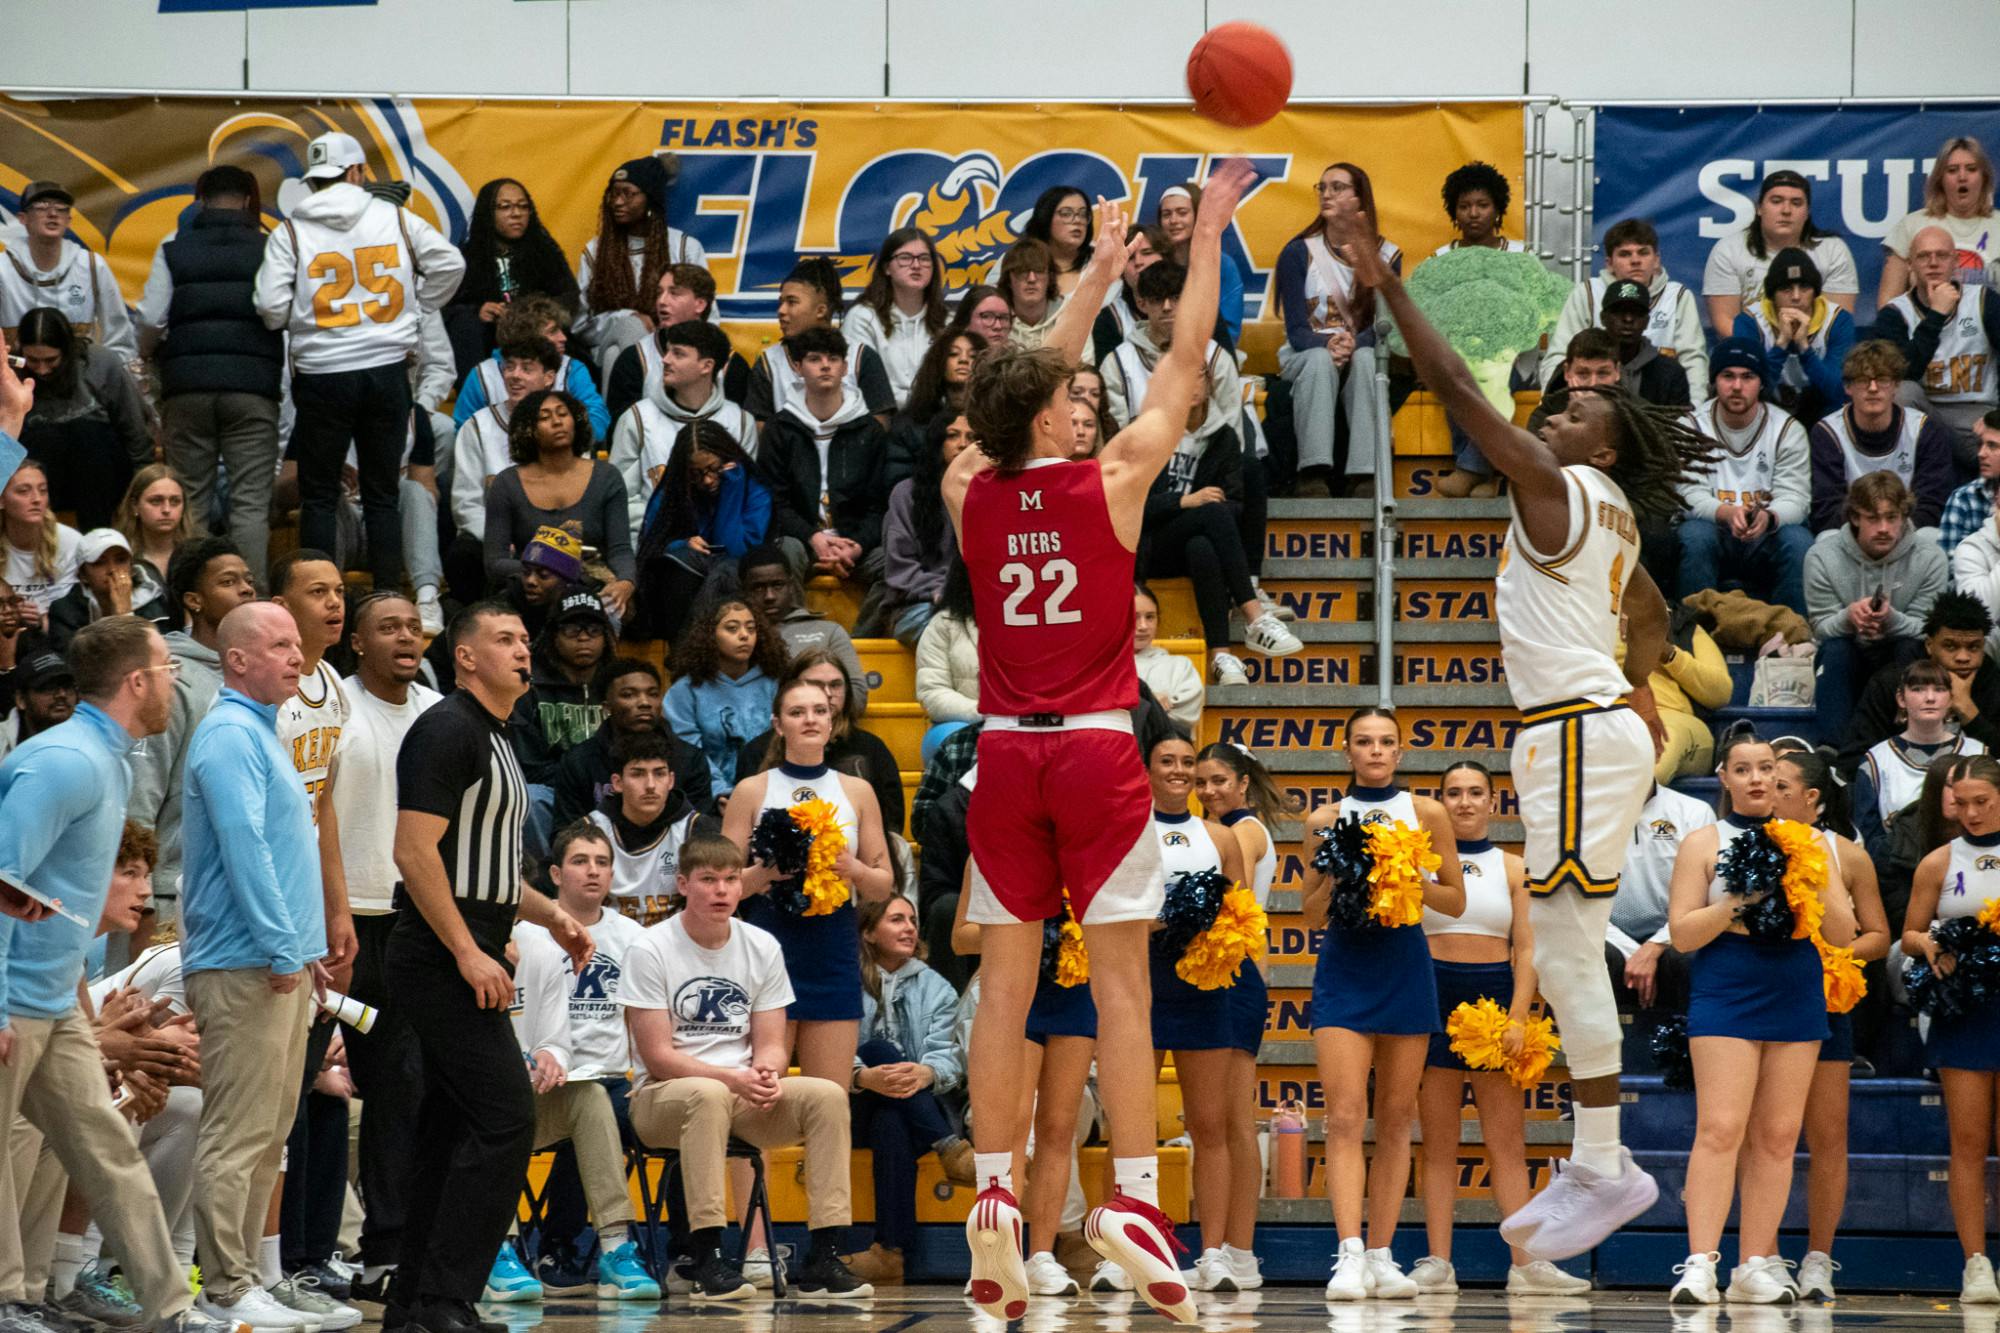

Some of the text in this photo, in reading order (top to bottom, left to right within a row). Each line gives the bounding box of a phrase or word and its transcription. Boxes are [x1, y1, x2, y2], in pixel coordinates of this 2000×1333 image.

[660, 117, 818, 147] FLASH'S
[1698, 160, 1940, 238] STU
[307, 243, 404, 329] 25
[1926, 354, 1988, 396] ENT
[1019, 489, 1043, 511] M
[1007, 531, 1062, 556] BYERS
[1268, 533, 1505, 558] LDEN FLASH
[999, 558, 1082, 626] 22
[1269, 591, 1497, 619] NT STA
[1246, 658, 1507, 683] OLDEN FLASH
[1220, 718, 1524, 749] KENT STAT
[1267, 928, 1327, 955] LDE
[707, 1025, 743, 1034] STATE
